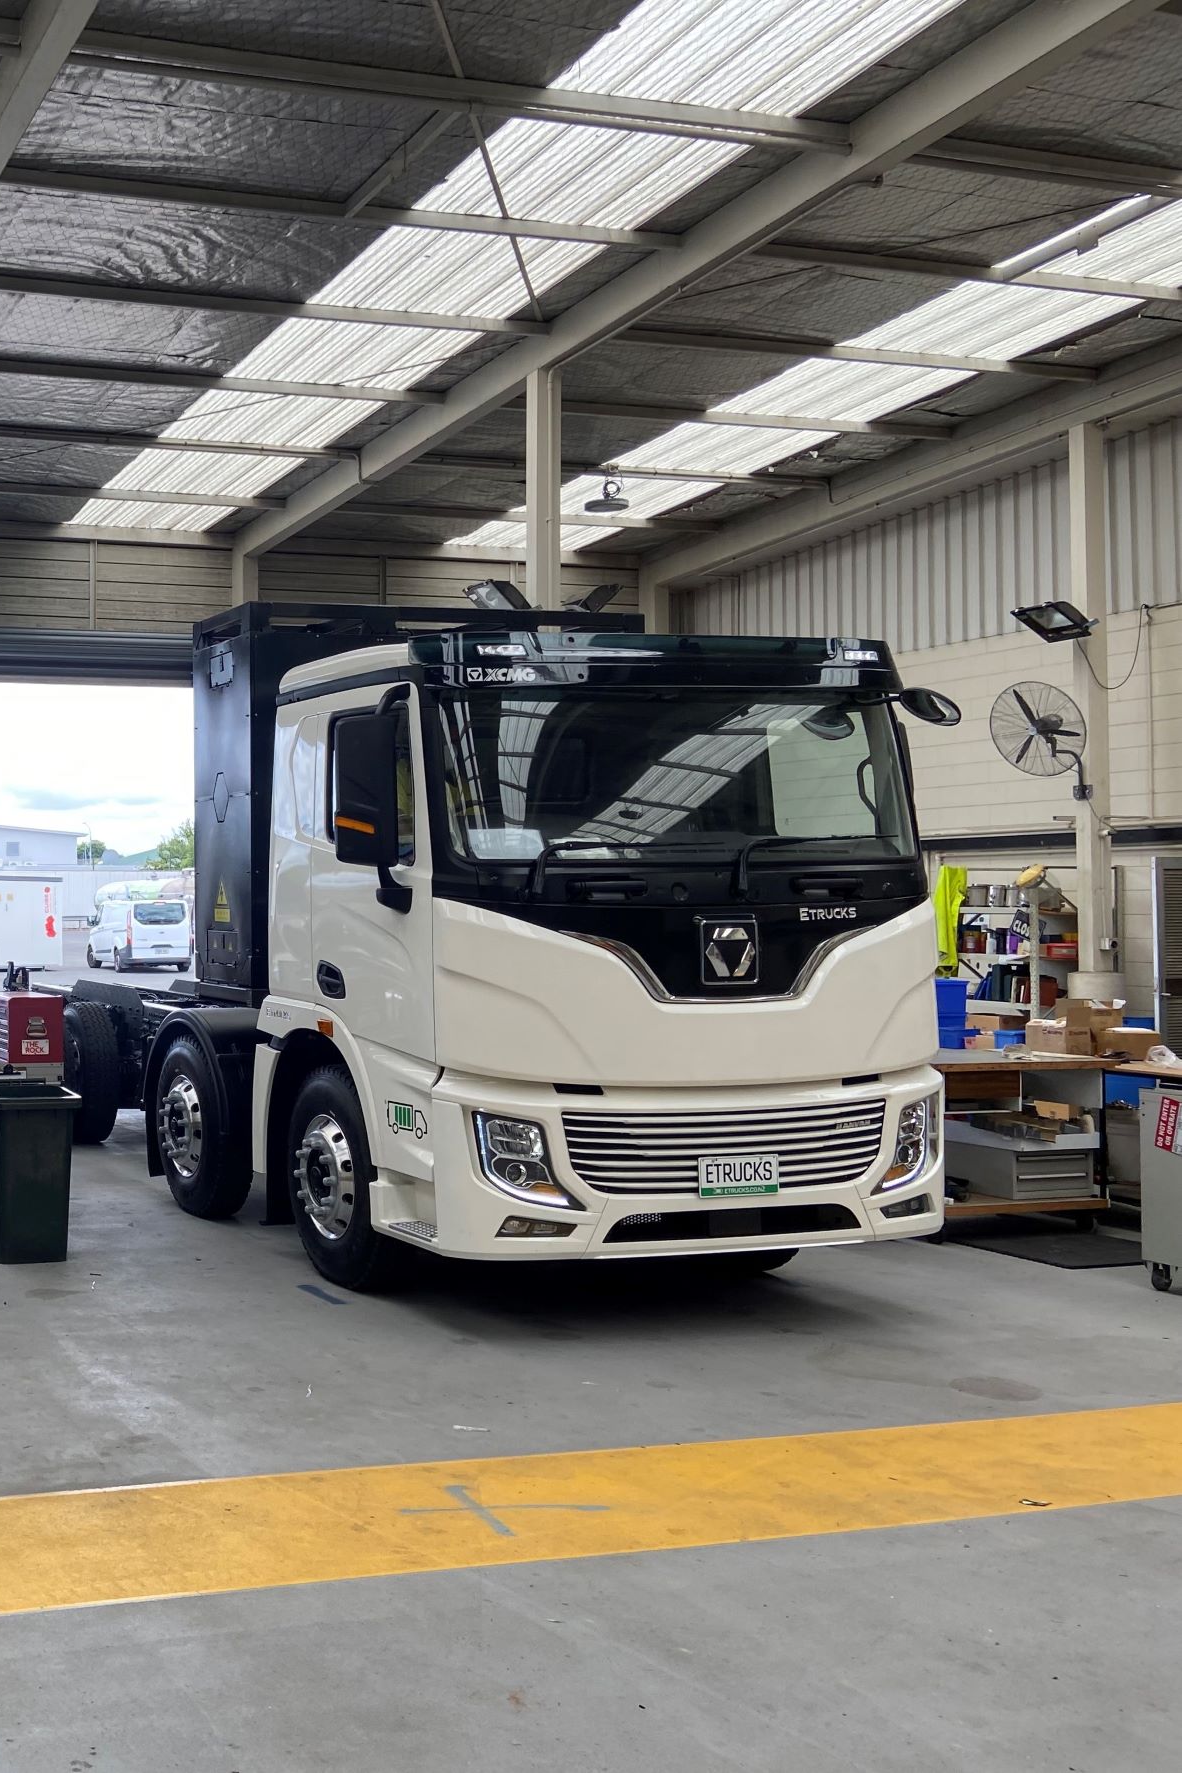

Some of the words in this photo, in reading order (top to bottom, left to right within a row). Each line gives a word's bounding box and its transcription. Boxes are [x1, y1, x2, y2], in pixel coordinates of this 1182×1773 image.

[484, 667, 536, 681] XCMG
[1157, 1137, 1164, 1147] DO
[1162, 1099, 1170, 1121] ENTER
[1167, 1105, 1178, 1135] OPERATE
[1165, 1135, 1172, 1146] OR
[706, 1161, 773, 1184] ETRUCKS
